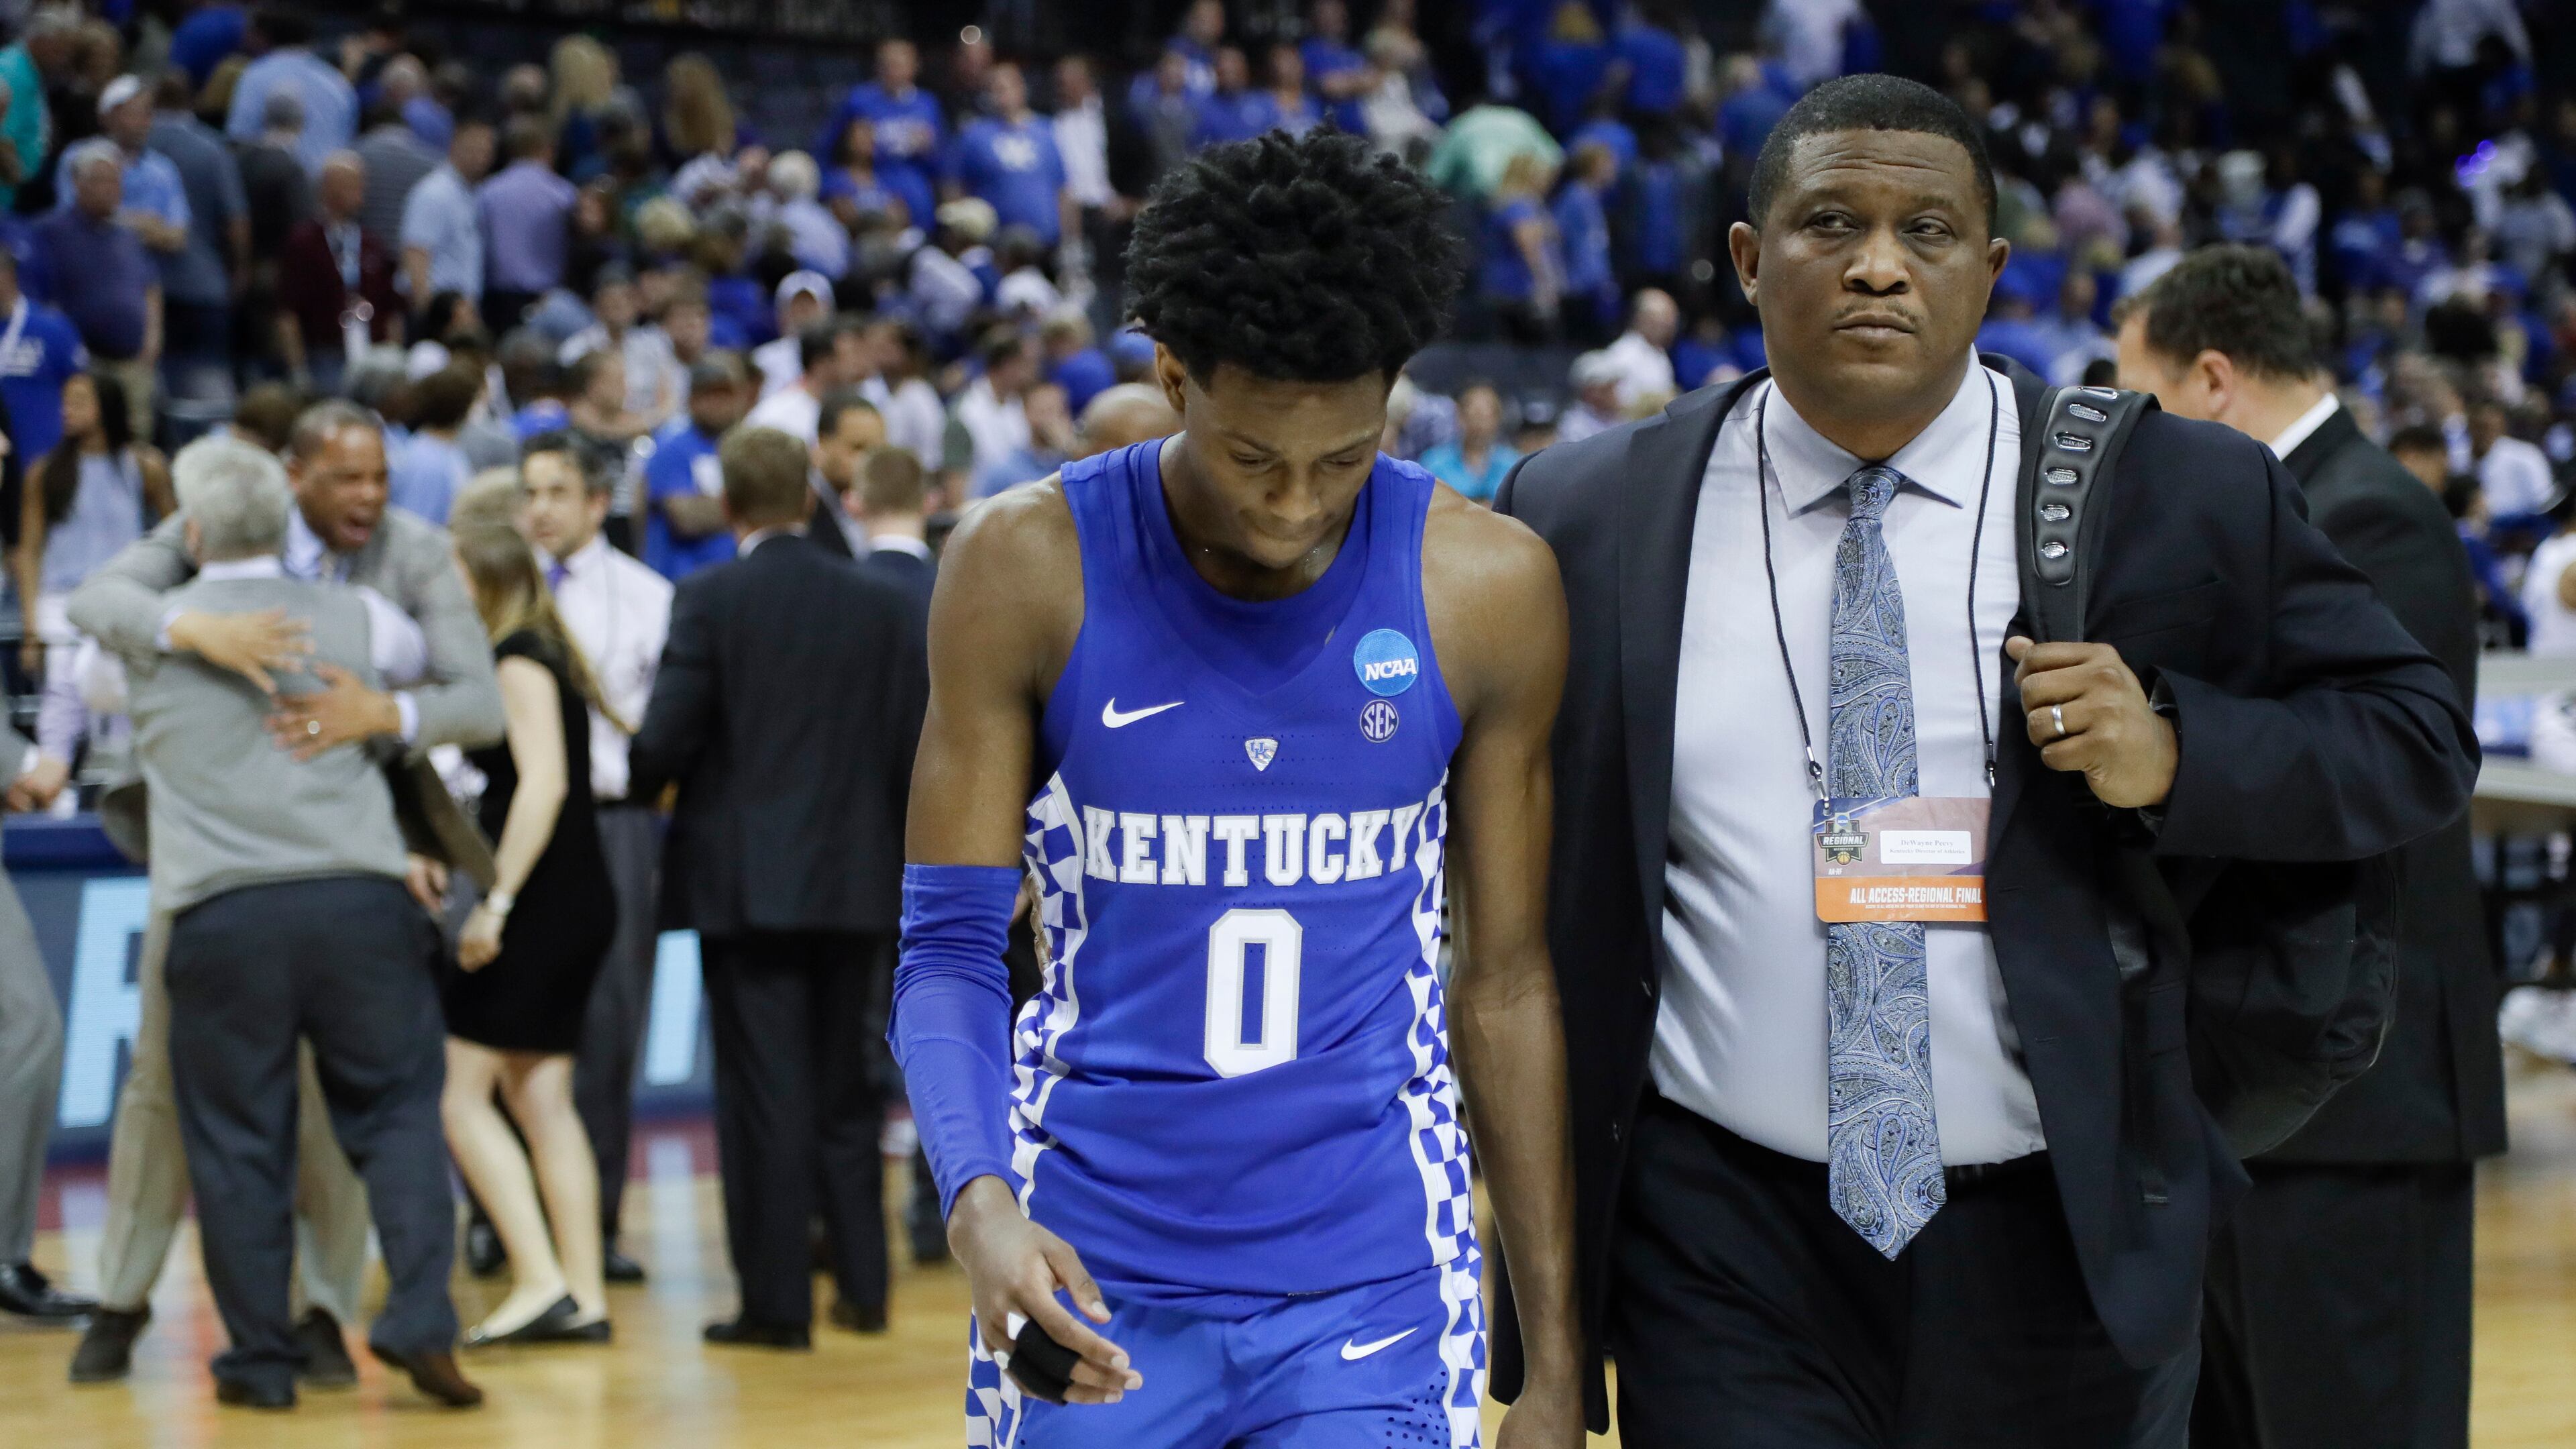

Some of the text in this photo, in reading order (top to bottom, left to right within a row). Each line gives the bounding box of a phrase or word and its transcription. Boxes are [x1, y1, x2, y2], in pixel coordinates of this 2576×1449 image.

[1364, 657, 1417, 682] NCAA
[1364, 702, 1396, 739] SEC
[1250, 742, 1270, 759] UK
[1082, 800, 1424, 887] KENTUCKY
[1823, 836, 1864, 845] REGIONAL
[1849, 887, 1982, 904] ALL ACCESS-REGIONAL FINAL
[1203, 908, 1303, 1079] 0
